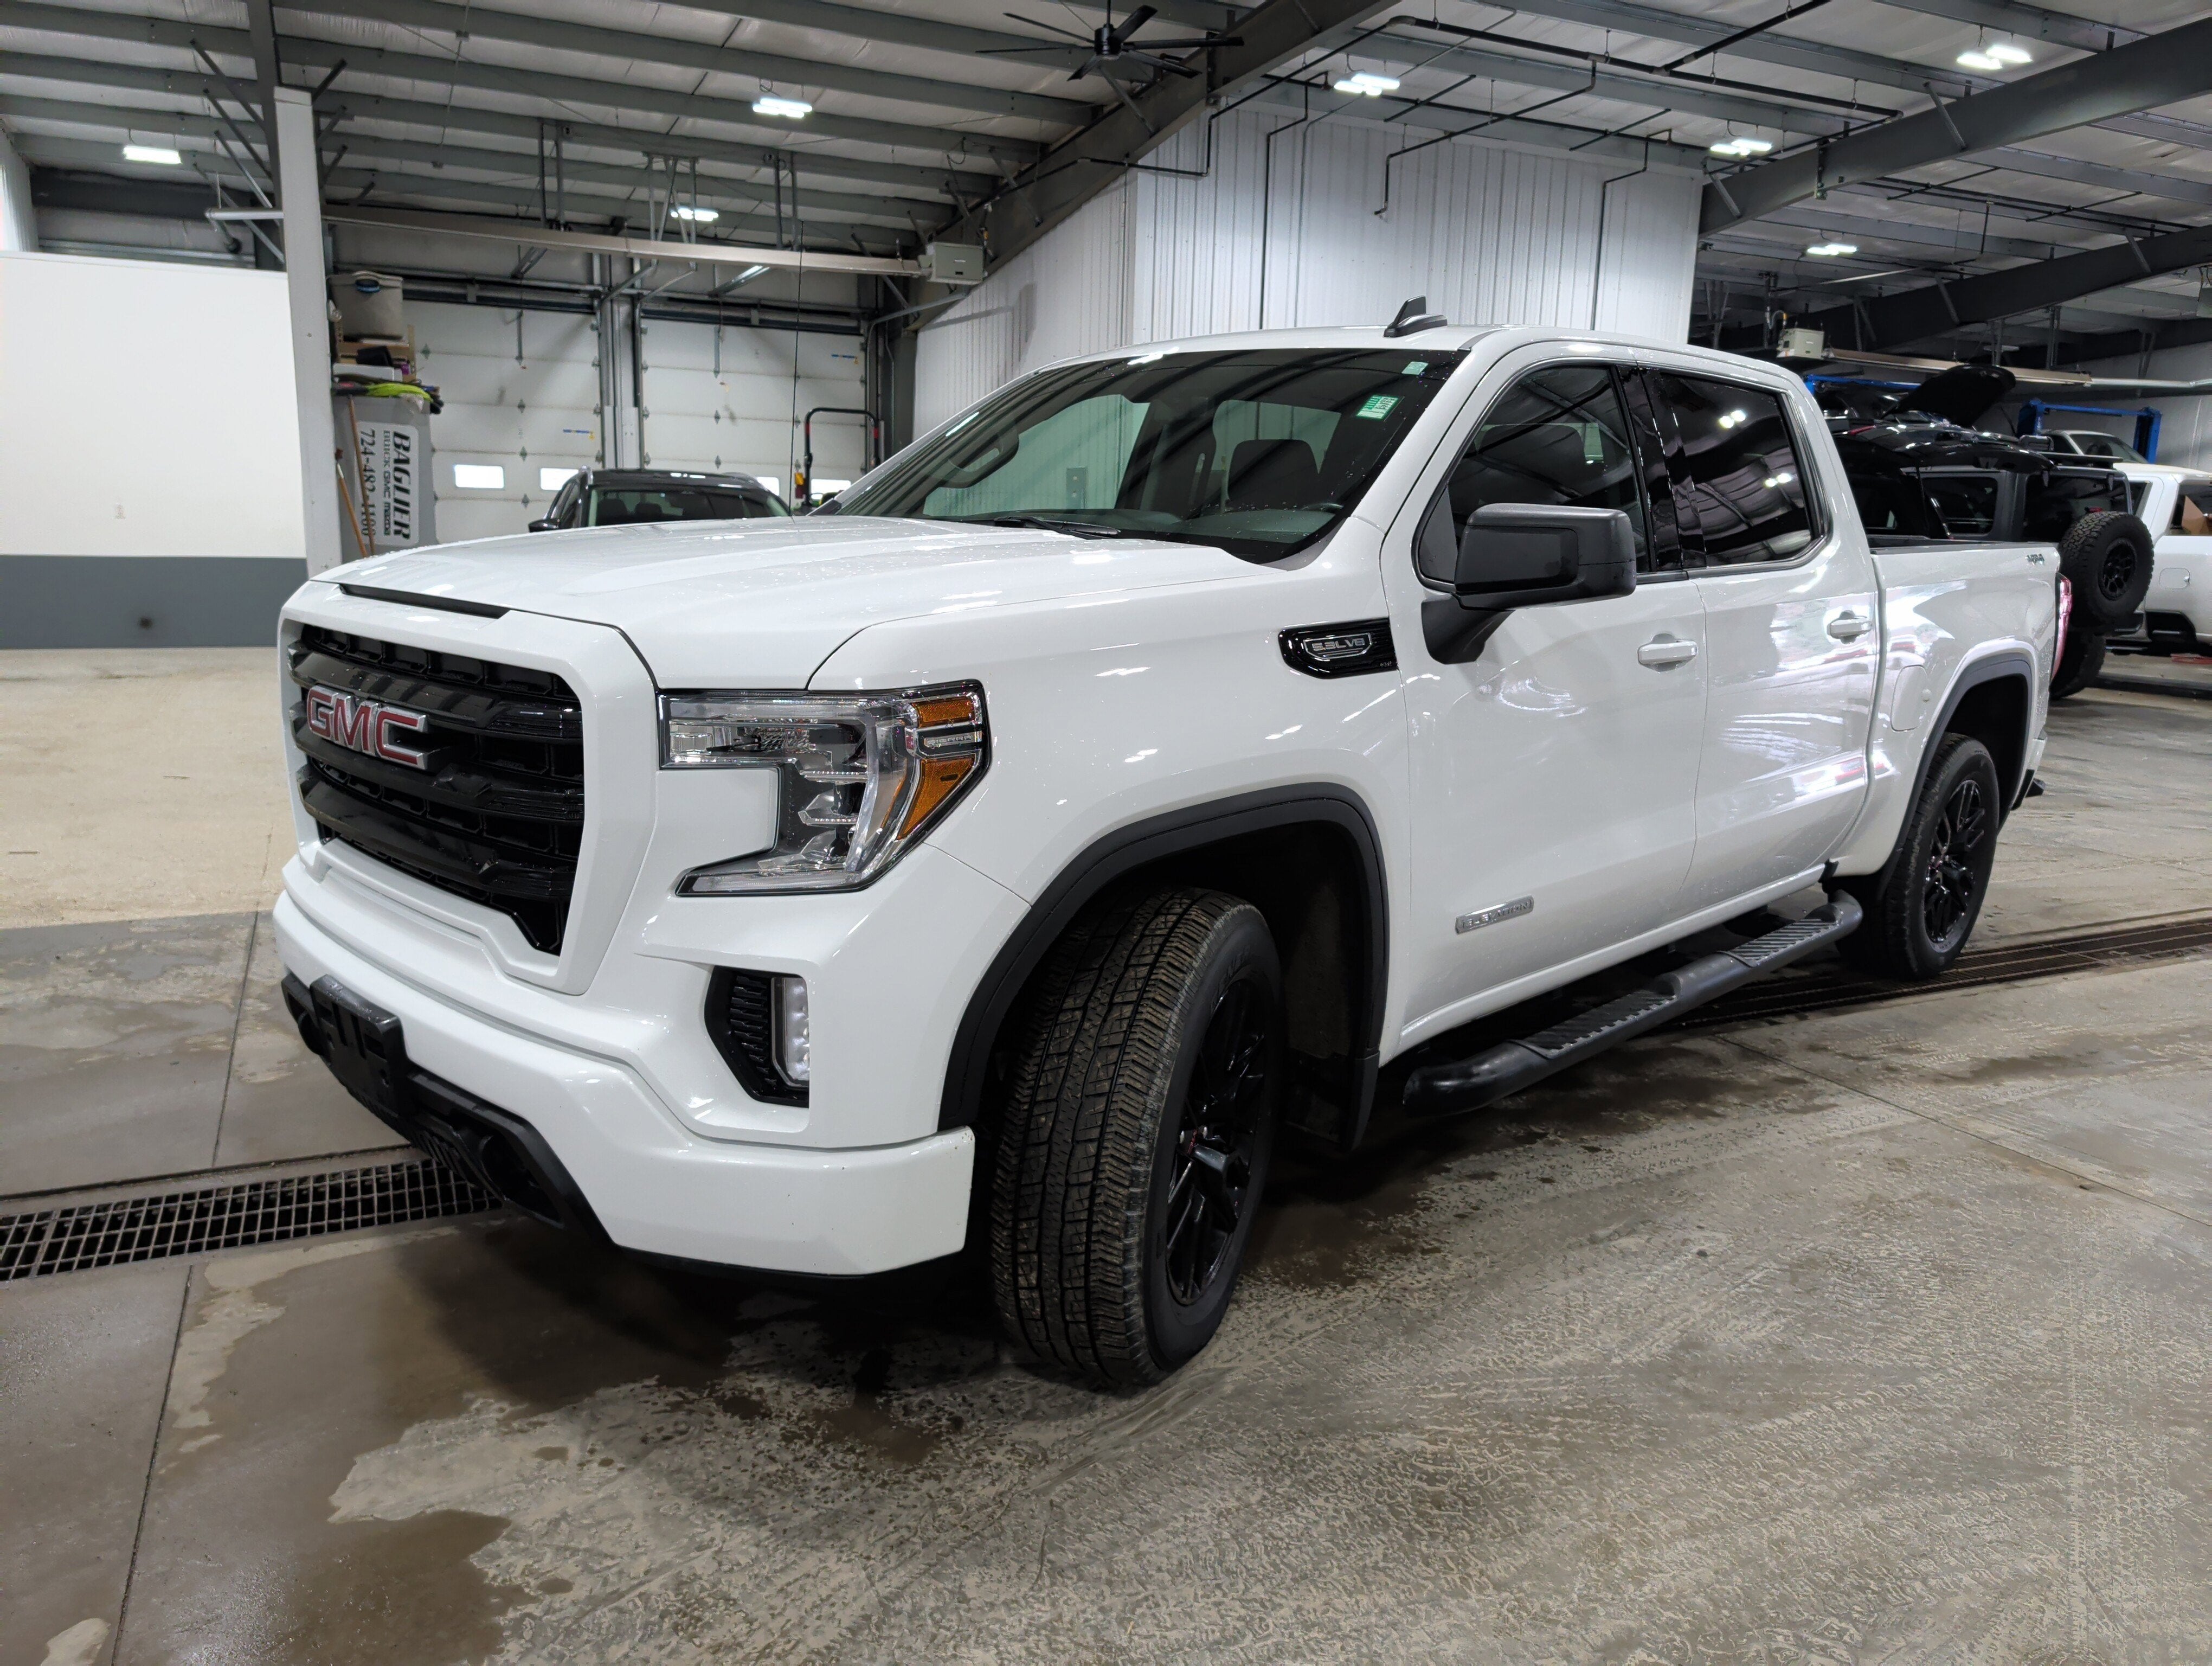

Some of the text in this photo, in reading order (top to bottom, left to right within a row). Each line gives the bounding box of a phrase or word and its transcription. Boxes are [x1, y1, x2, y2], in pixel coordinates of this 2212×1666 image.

[393, 431, 411, 540] BAGLIER
[307, 685, 427, 770] GMC
[927, 735, 972, 746] SIERRA
